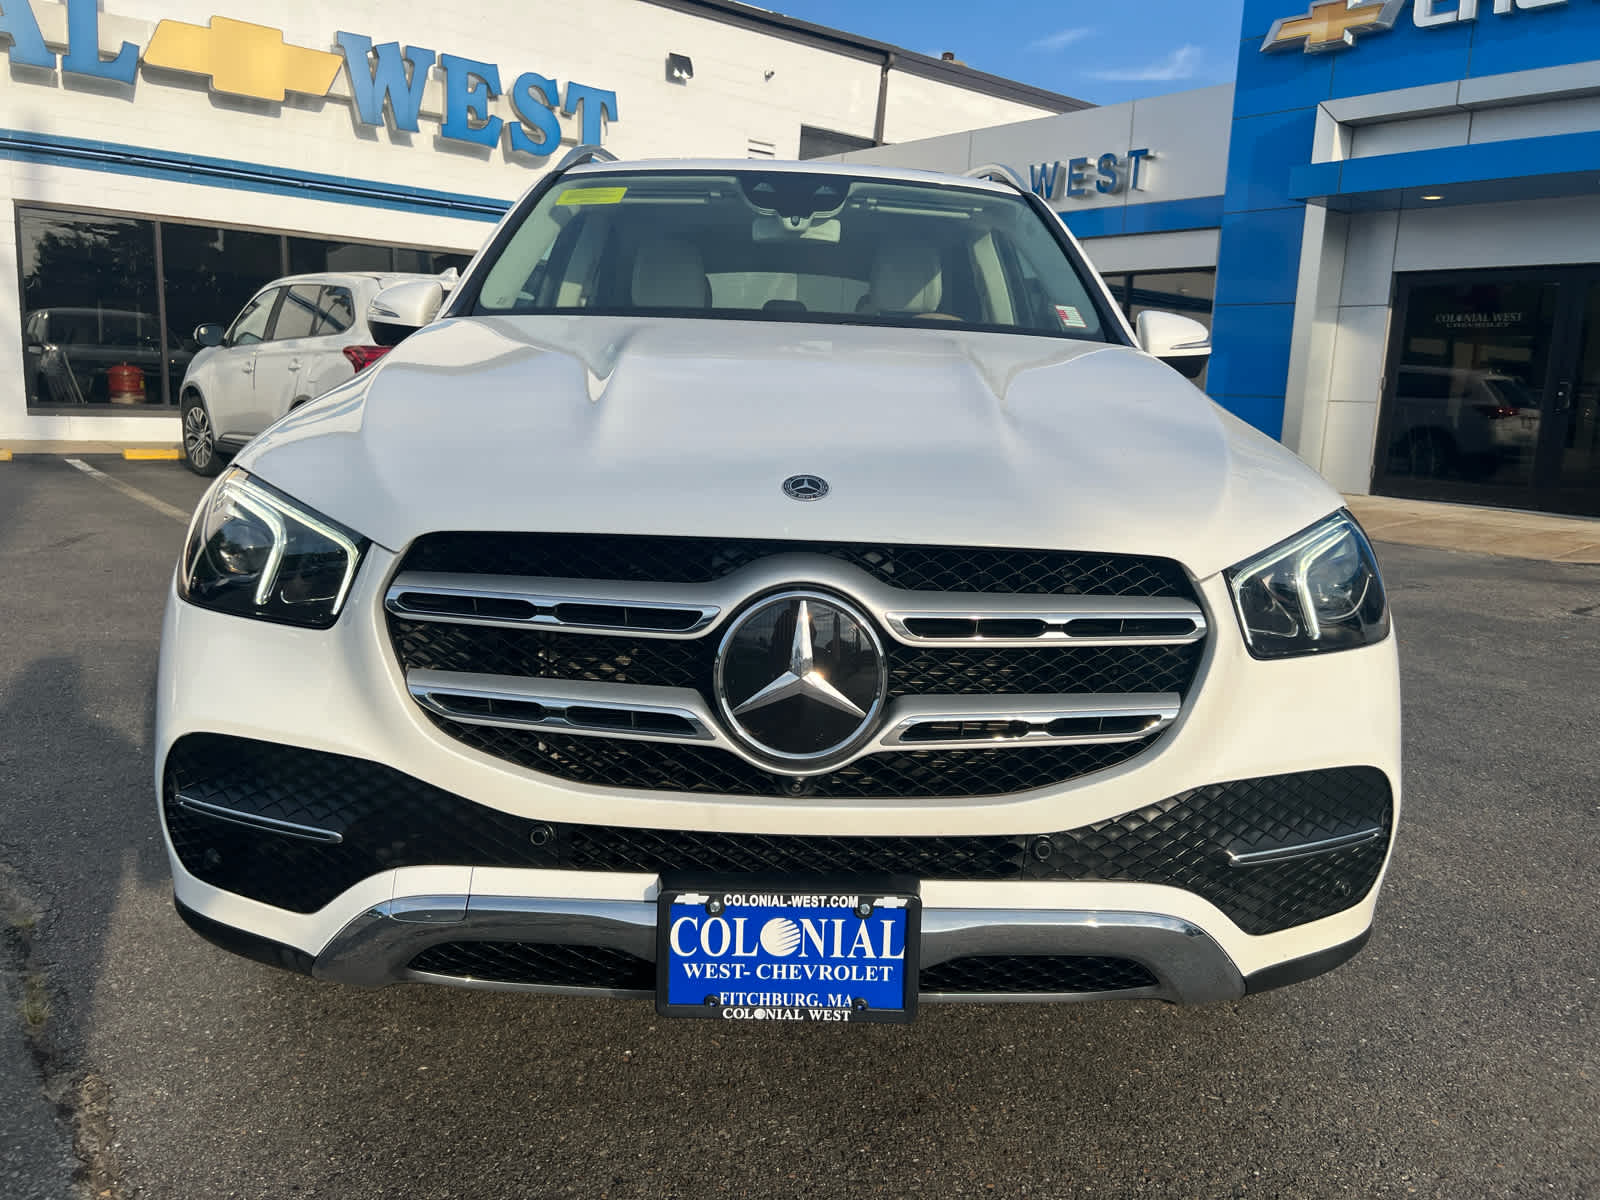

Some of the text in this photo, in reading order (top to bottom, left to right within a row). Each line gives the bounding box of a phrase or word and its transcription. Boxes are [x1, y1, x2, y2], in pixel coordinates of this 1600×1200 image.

[334, 30, 619, 157] WEST
[1029, 148, 1149, 199] WEST
[1492, 311, 1522, 322] WEST
[723, 894, 859, 909] COLONIAL-WEST.COM
[669, 916, 905, 960] COLONIAL
[756, 963, 893, 982] CHEVROLET
[827, 993, 852, 1008] MA
[722, 1007, 852, 1022] COLONIAL WEST
